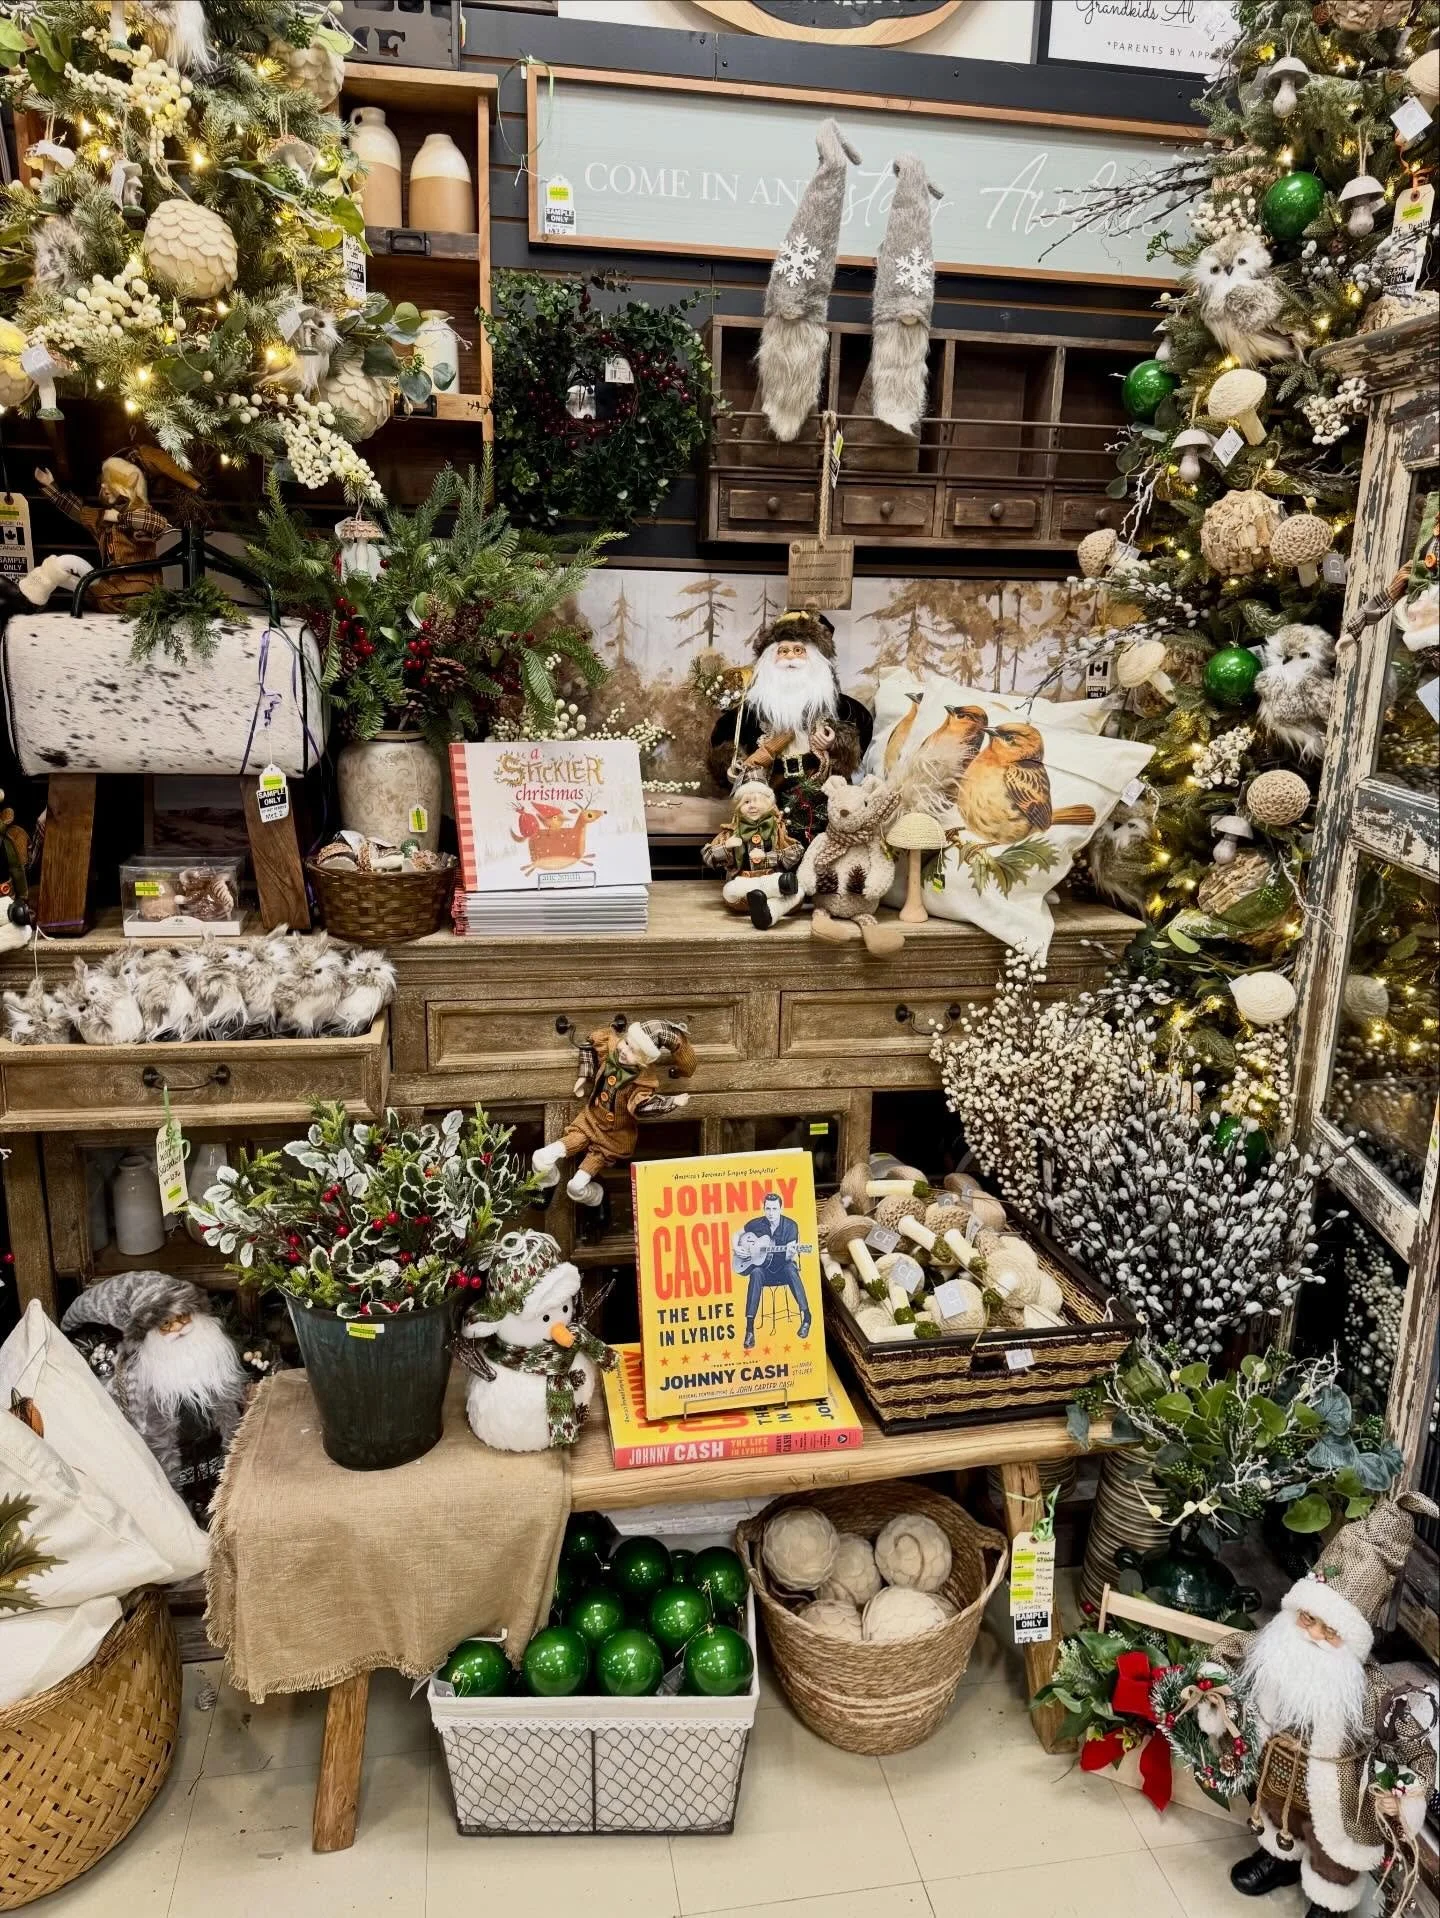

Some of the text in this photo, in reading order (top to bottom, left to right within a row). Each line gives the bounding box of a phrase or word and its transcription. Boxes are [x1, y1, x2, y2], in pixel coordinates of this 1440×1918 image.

[1161, 0, 1195, 23] Al
[1169, 47, 1182, 56] BY
[1189, 50, 1211, 60] APP
[584, 162, 692, 199] COME
[700, 171, 741, 201] IN
[748, 175, 811, 207] AN
[546, 208, 574, 216] SAMPLE
[550, 215, 569, 223] ONLY
[530, 748, 539, 759] a
[500, 754, 605, 787] STICKLER
[258, 788, 286, 799] SAMPLE
[515, 783, 584, 801] christmas
[264, 796, 281, 805] ONLY
[653, 1177, 798, 1219] JOHNNY
[873, 1230, 895, 1243] CF
[652, 1221, 733, 1301] CASH
[657, 1302, 735, 1325] THE LIFE
[659, 1324, 735, 1347] IN LYRICS
[660, 1364, 789, 1391] JOHNNY CASH
[779, 1380, 795, 1388] CASH
[730, 1437, 768, 1448] THE LIFE
[783, 1434, 792, 1452] CASH
[628, 1441, 724, 1466] JOHNNY CASH
[731, 1446, 768, 1457] IN LYRICS
[1016, 1611, 1048, 1620] SAMPLE
[1021, 1620, 1043, 1628] ONLY
